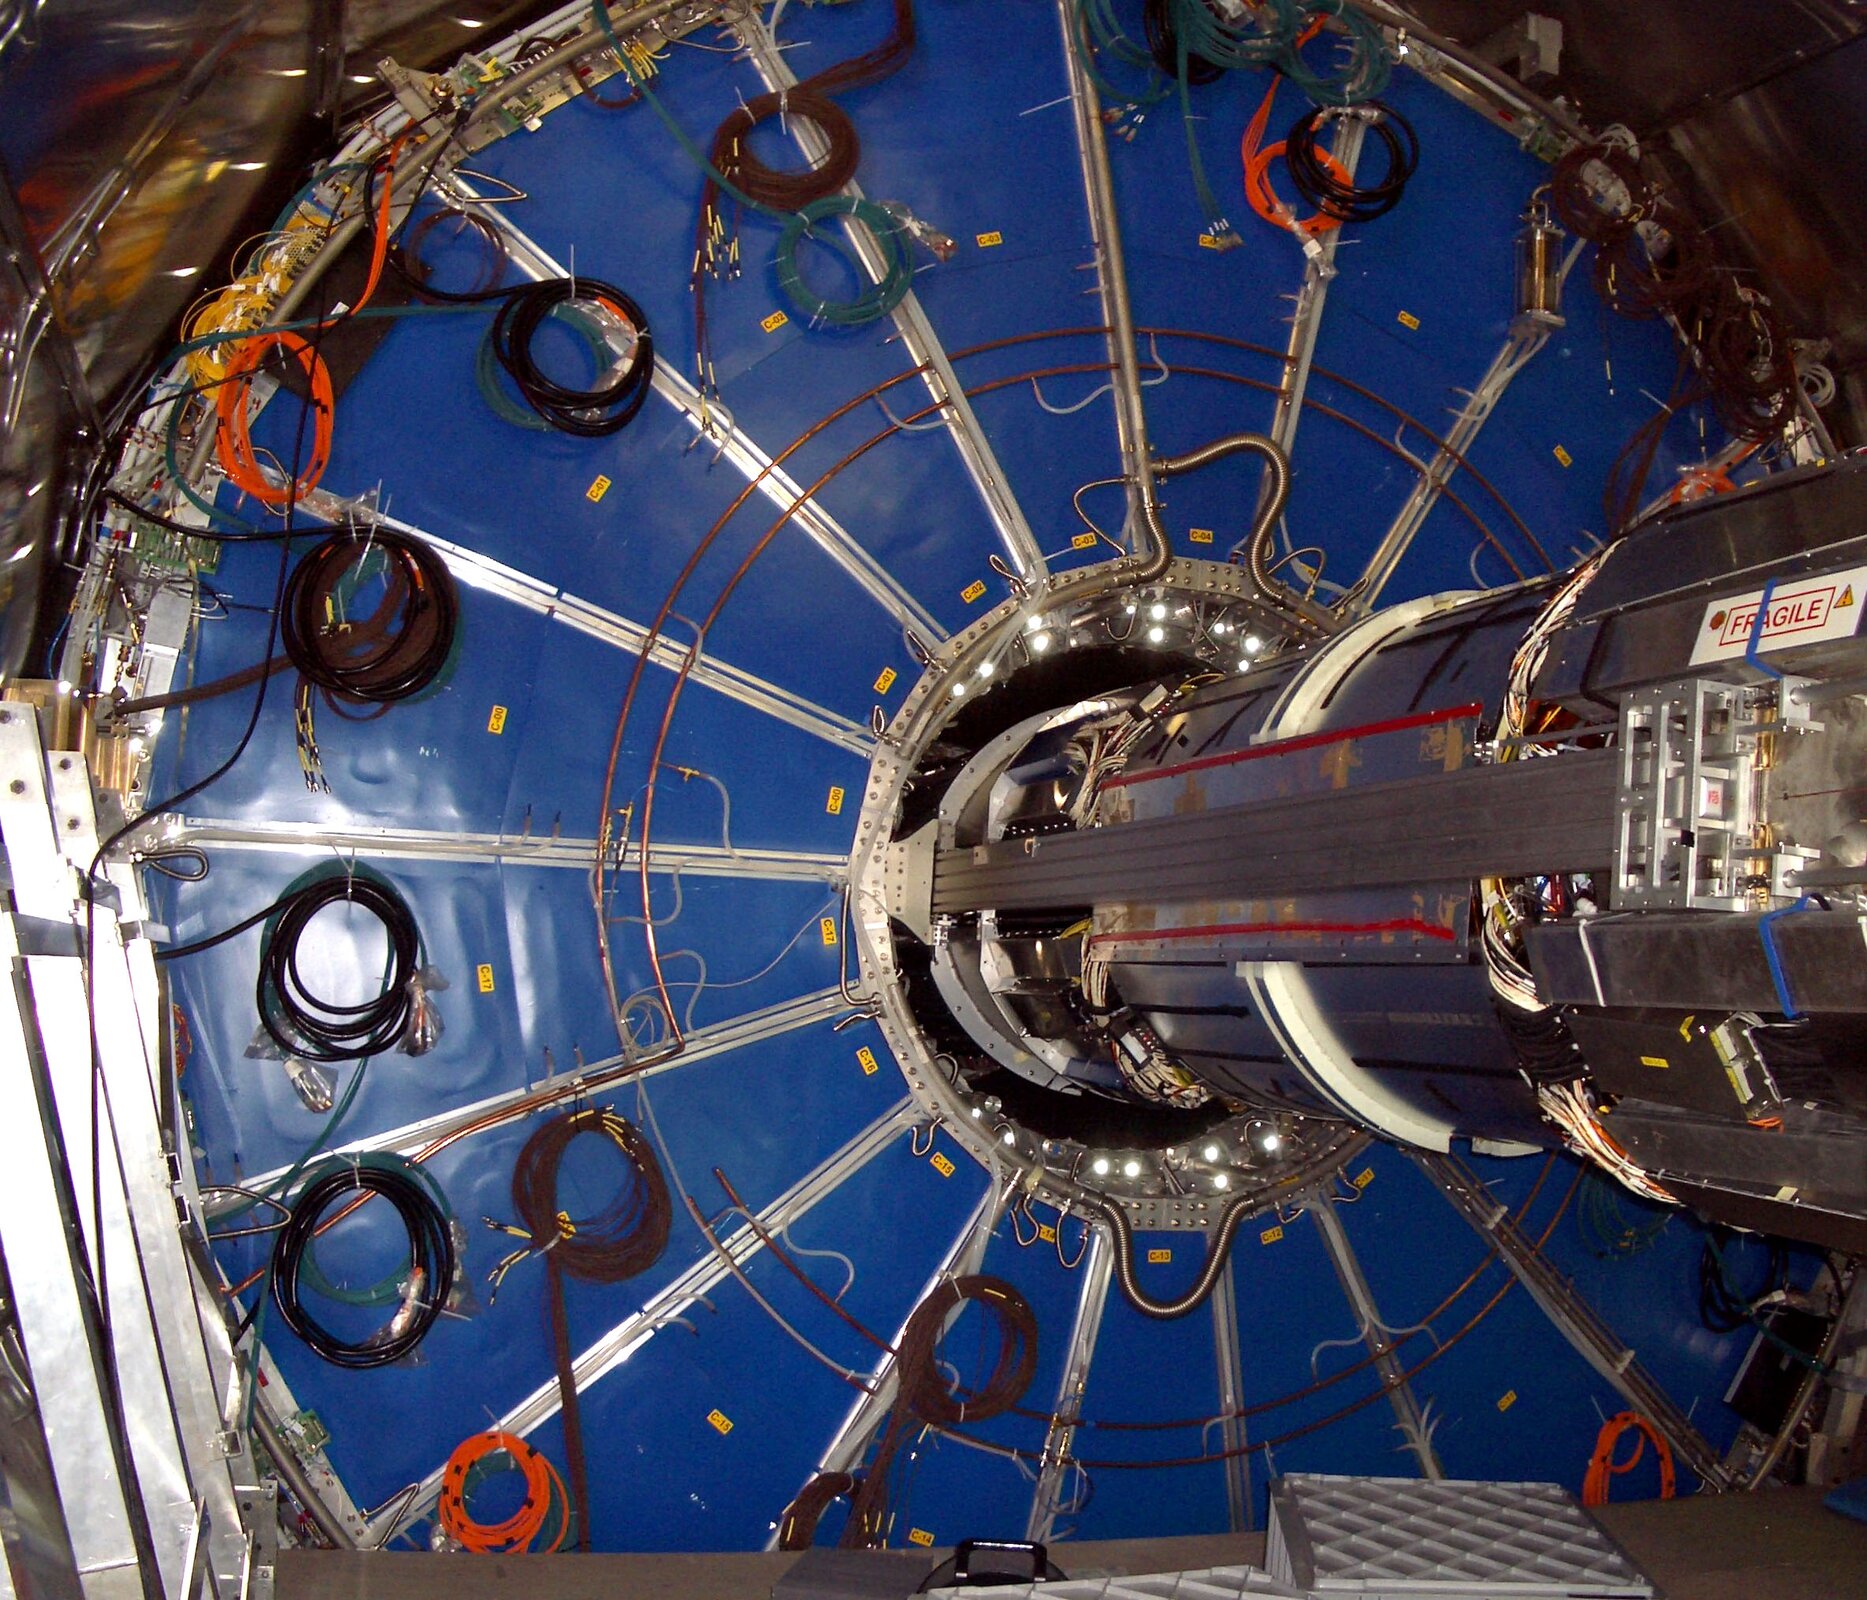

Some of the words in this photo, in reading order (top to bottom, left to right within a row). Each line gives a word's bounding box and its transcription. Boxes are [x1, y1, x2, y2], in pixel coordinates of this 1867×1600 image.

[979, 233, 1000, 245] C-03
[764, 312, 785, 329] C-02
[590, 478, 607, 498] C-01
[1073, 535, 1095, 547] C-03
[1191, 530, 1211, 541] C-04
[964, 582, 984, 599] C-02
[877, 670, 893, 690] C-01
[491, 707, 503, 731] C-00
[829, 789, 842, 811] C-00
[823, 919, 834, 942] C-17
[480, 966, 492, 989] C-17
[860, 1049, 876, 1072] C-16
[934, 1155, 952, 1174] C-15
[1262, 1228, 1281, 1241] C-12
[1150, 1252, 1169, 1261] C-13
[711, 1412, 729, 1431] C-15
